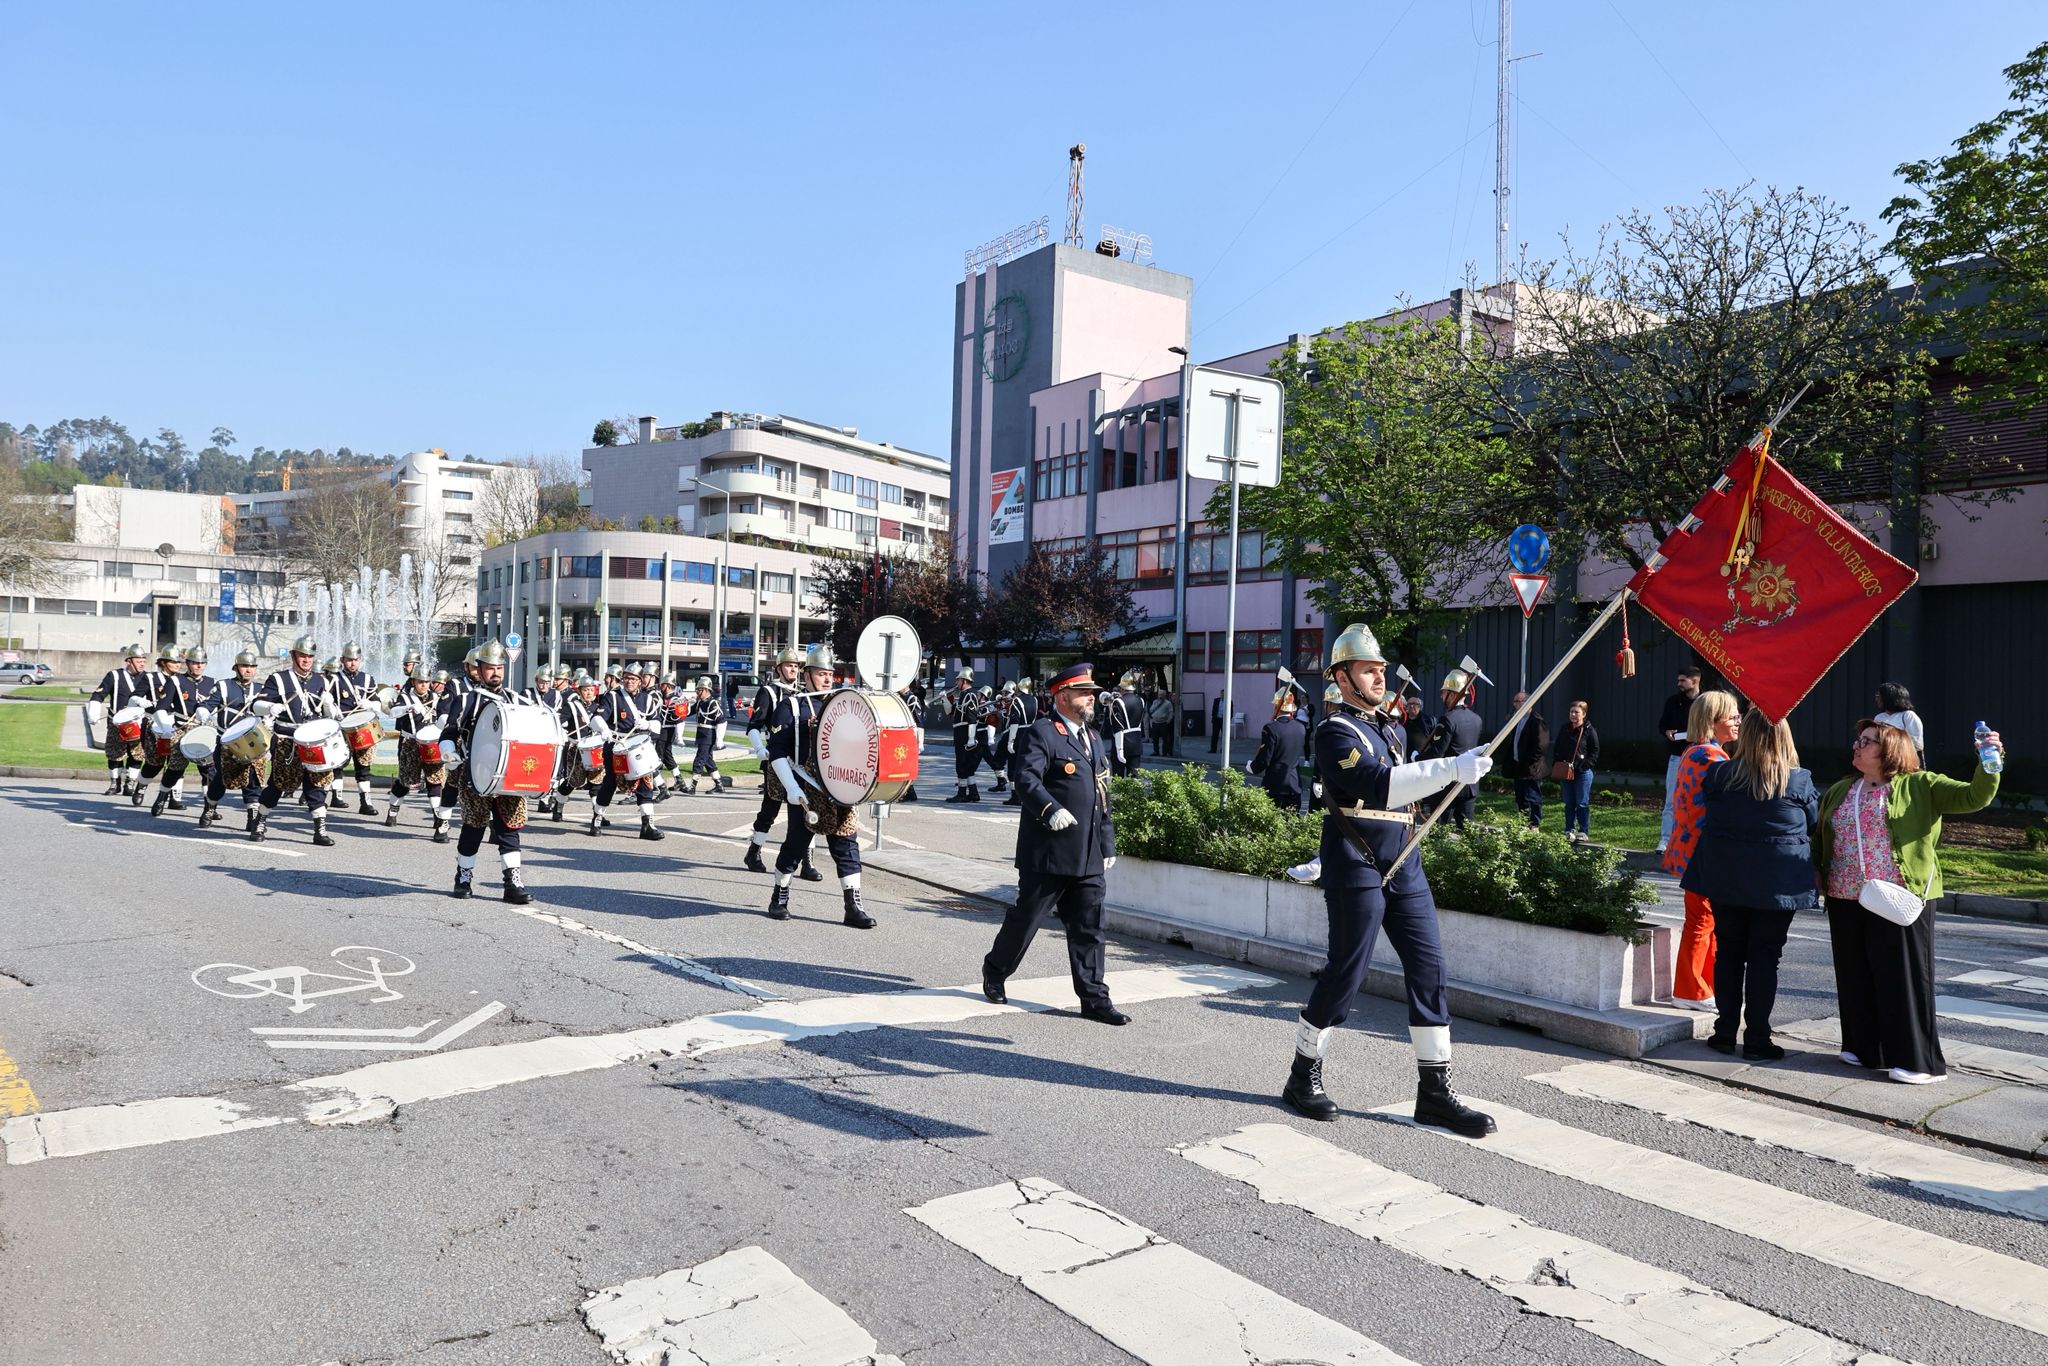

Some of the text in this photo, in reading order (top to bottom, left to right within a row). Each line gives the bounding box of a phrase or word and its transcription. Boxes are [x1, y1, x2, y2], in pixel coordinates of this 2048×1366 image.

[965, 215, 1049, 274] BOMBEIROS
[1101, 224, 1152, 258] BVG
[1758, 484, 1816, 524] OMBEIROS
[1709, 629, 1724, 646] DE
[821, 700, 878, 772] BOMBEIROS VOLUNTARIOS
[827, 765, 868, 788] GUIMARÃES
